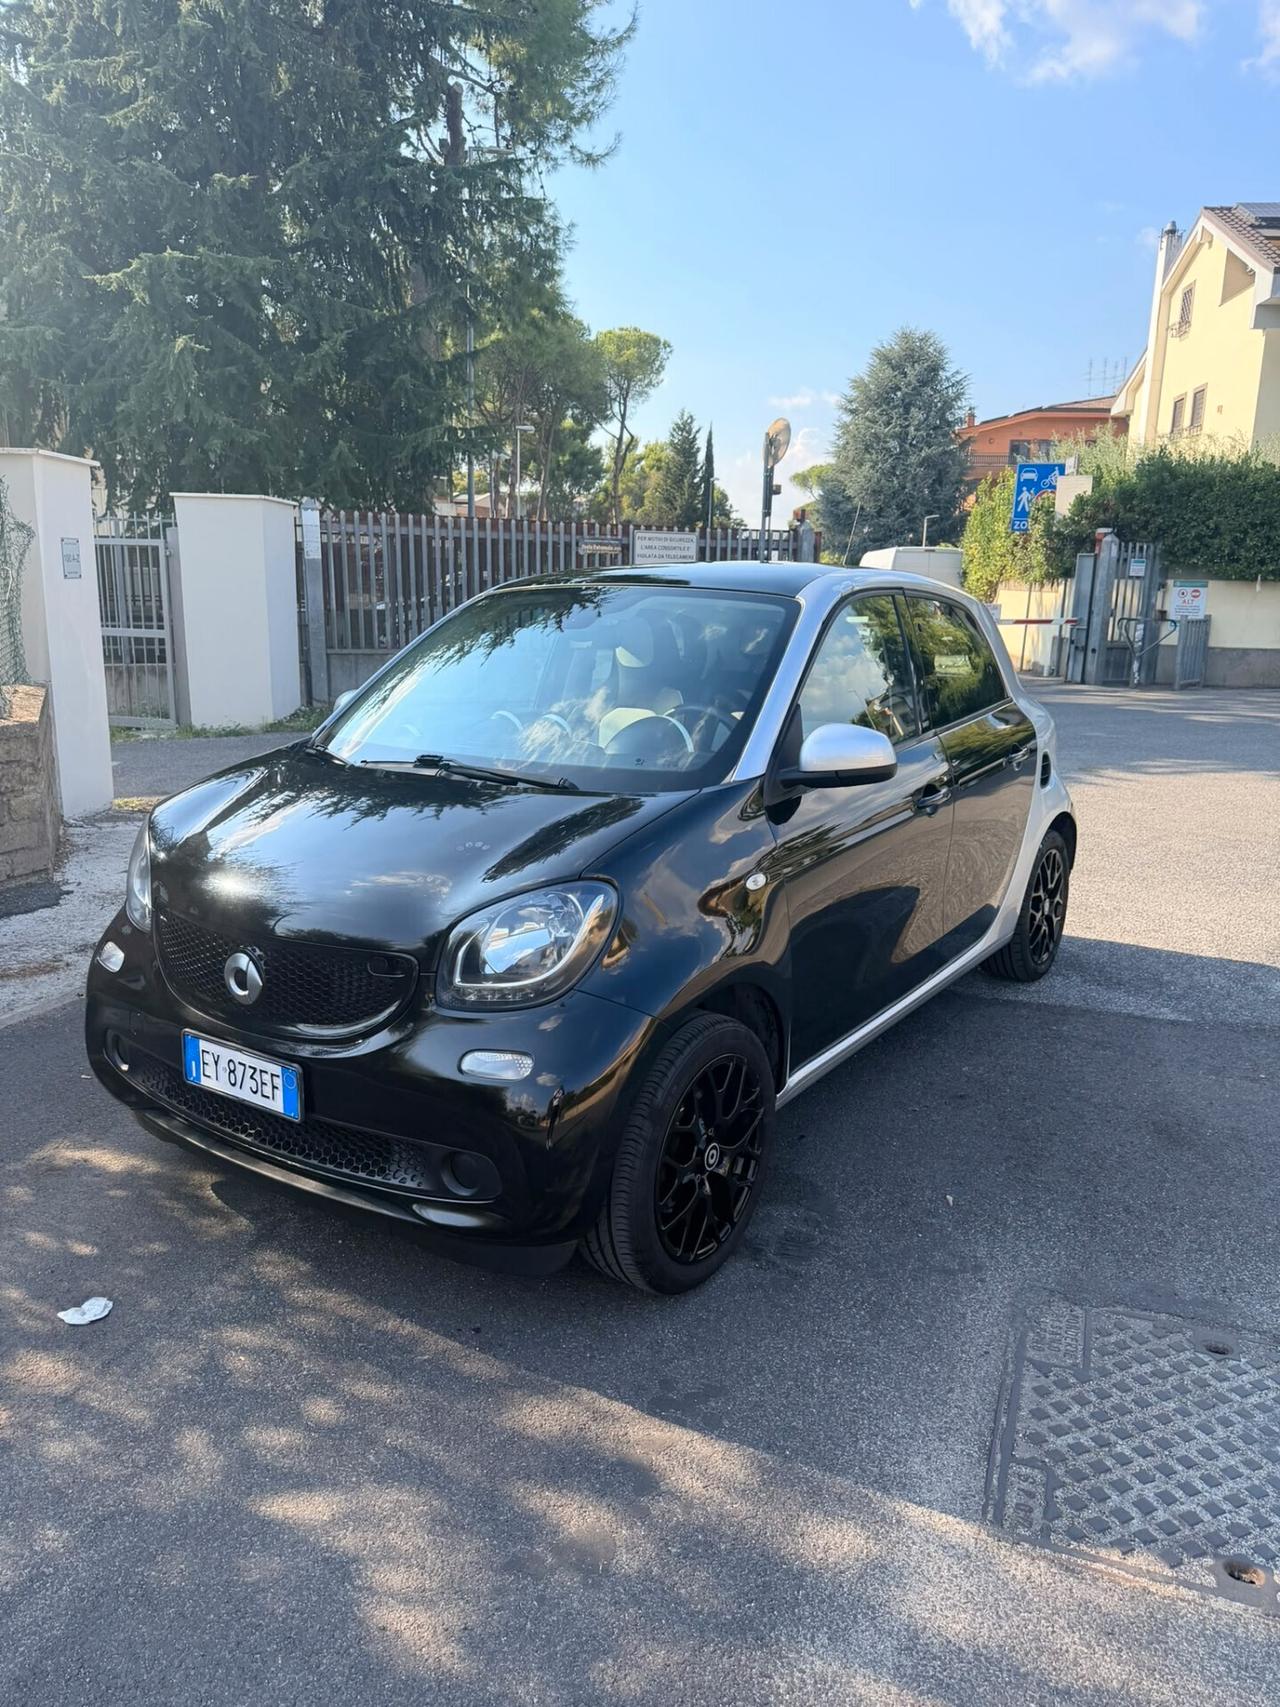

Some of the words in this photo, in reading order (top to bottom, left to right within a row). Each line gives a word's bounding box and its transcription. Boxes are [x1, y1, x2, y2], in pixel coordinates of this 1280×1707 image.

[1013, 520, 1028, 530] ZO
[201, 1049, 220, 1081] EY
[227, 1058, 280, 1101] 873EF
